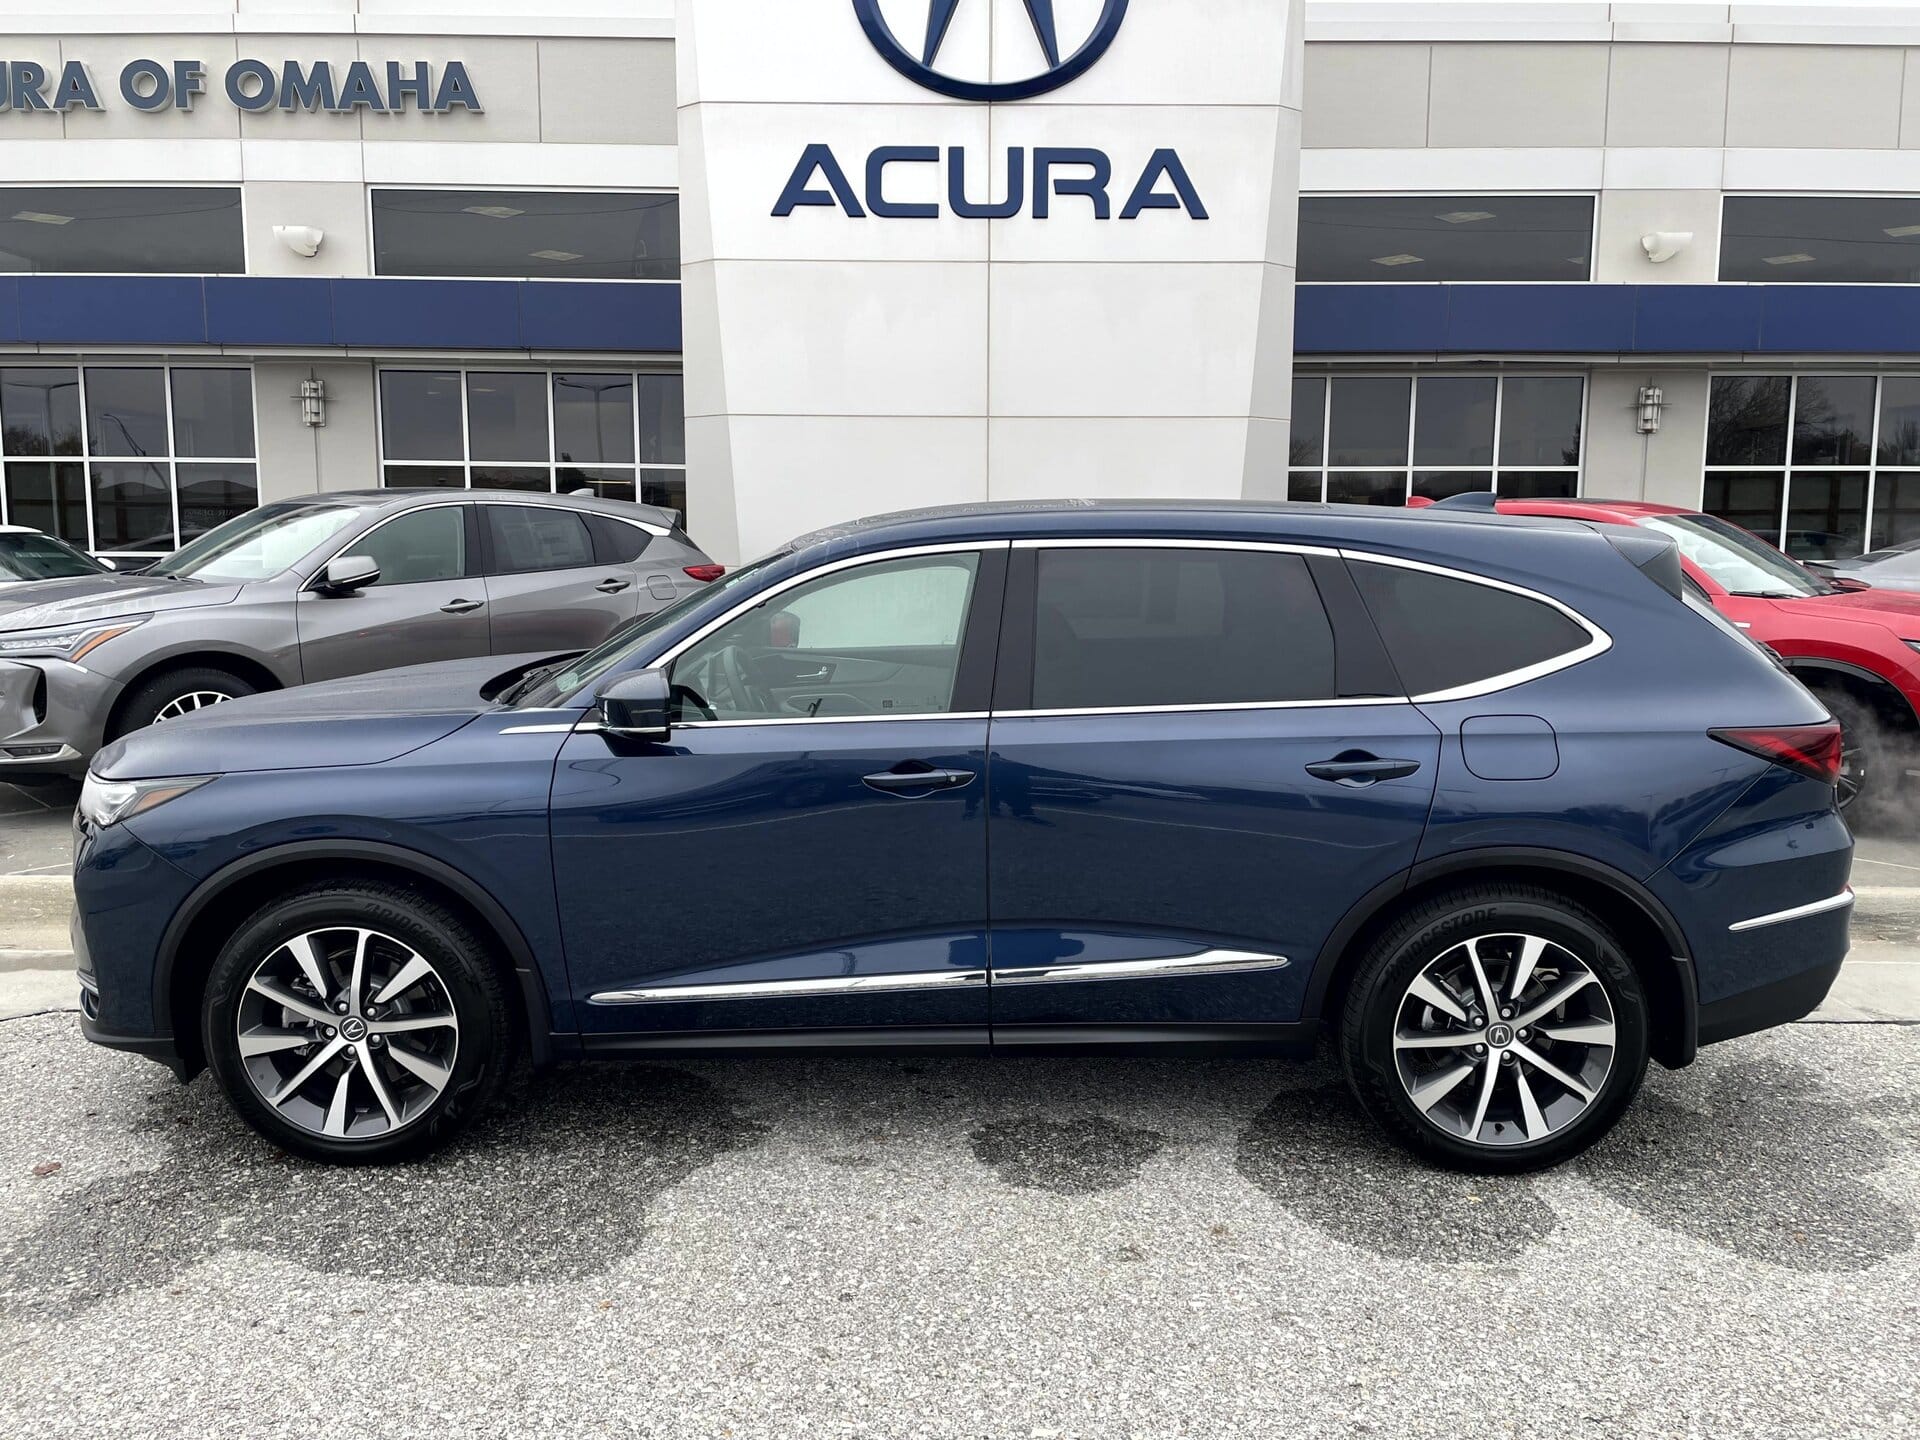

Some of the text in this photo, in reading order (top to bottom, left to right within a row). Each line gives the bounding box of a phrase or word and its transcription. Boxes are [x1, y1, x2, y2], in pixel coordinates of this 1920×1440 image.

[0, 58, 483, 113] RA OF OMAHA
[770, 143, 1210, 220] ACURA
